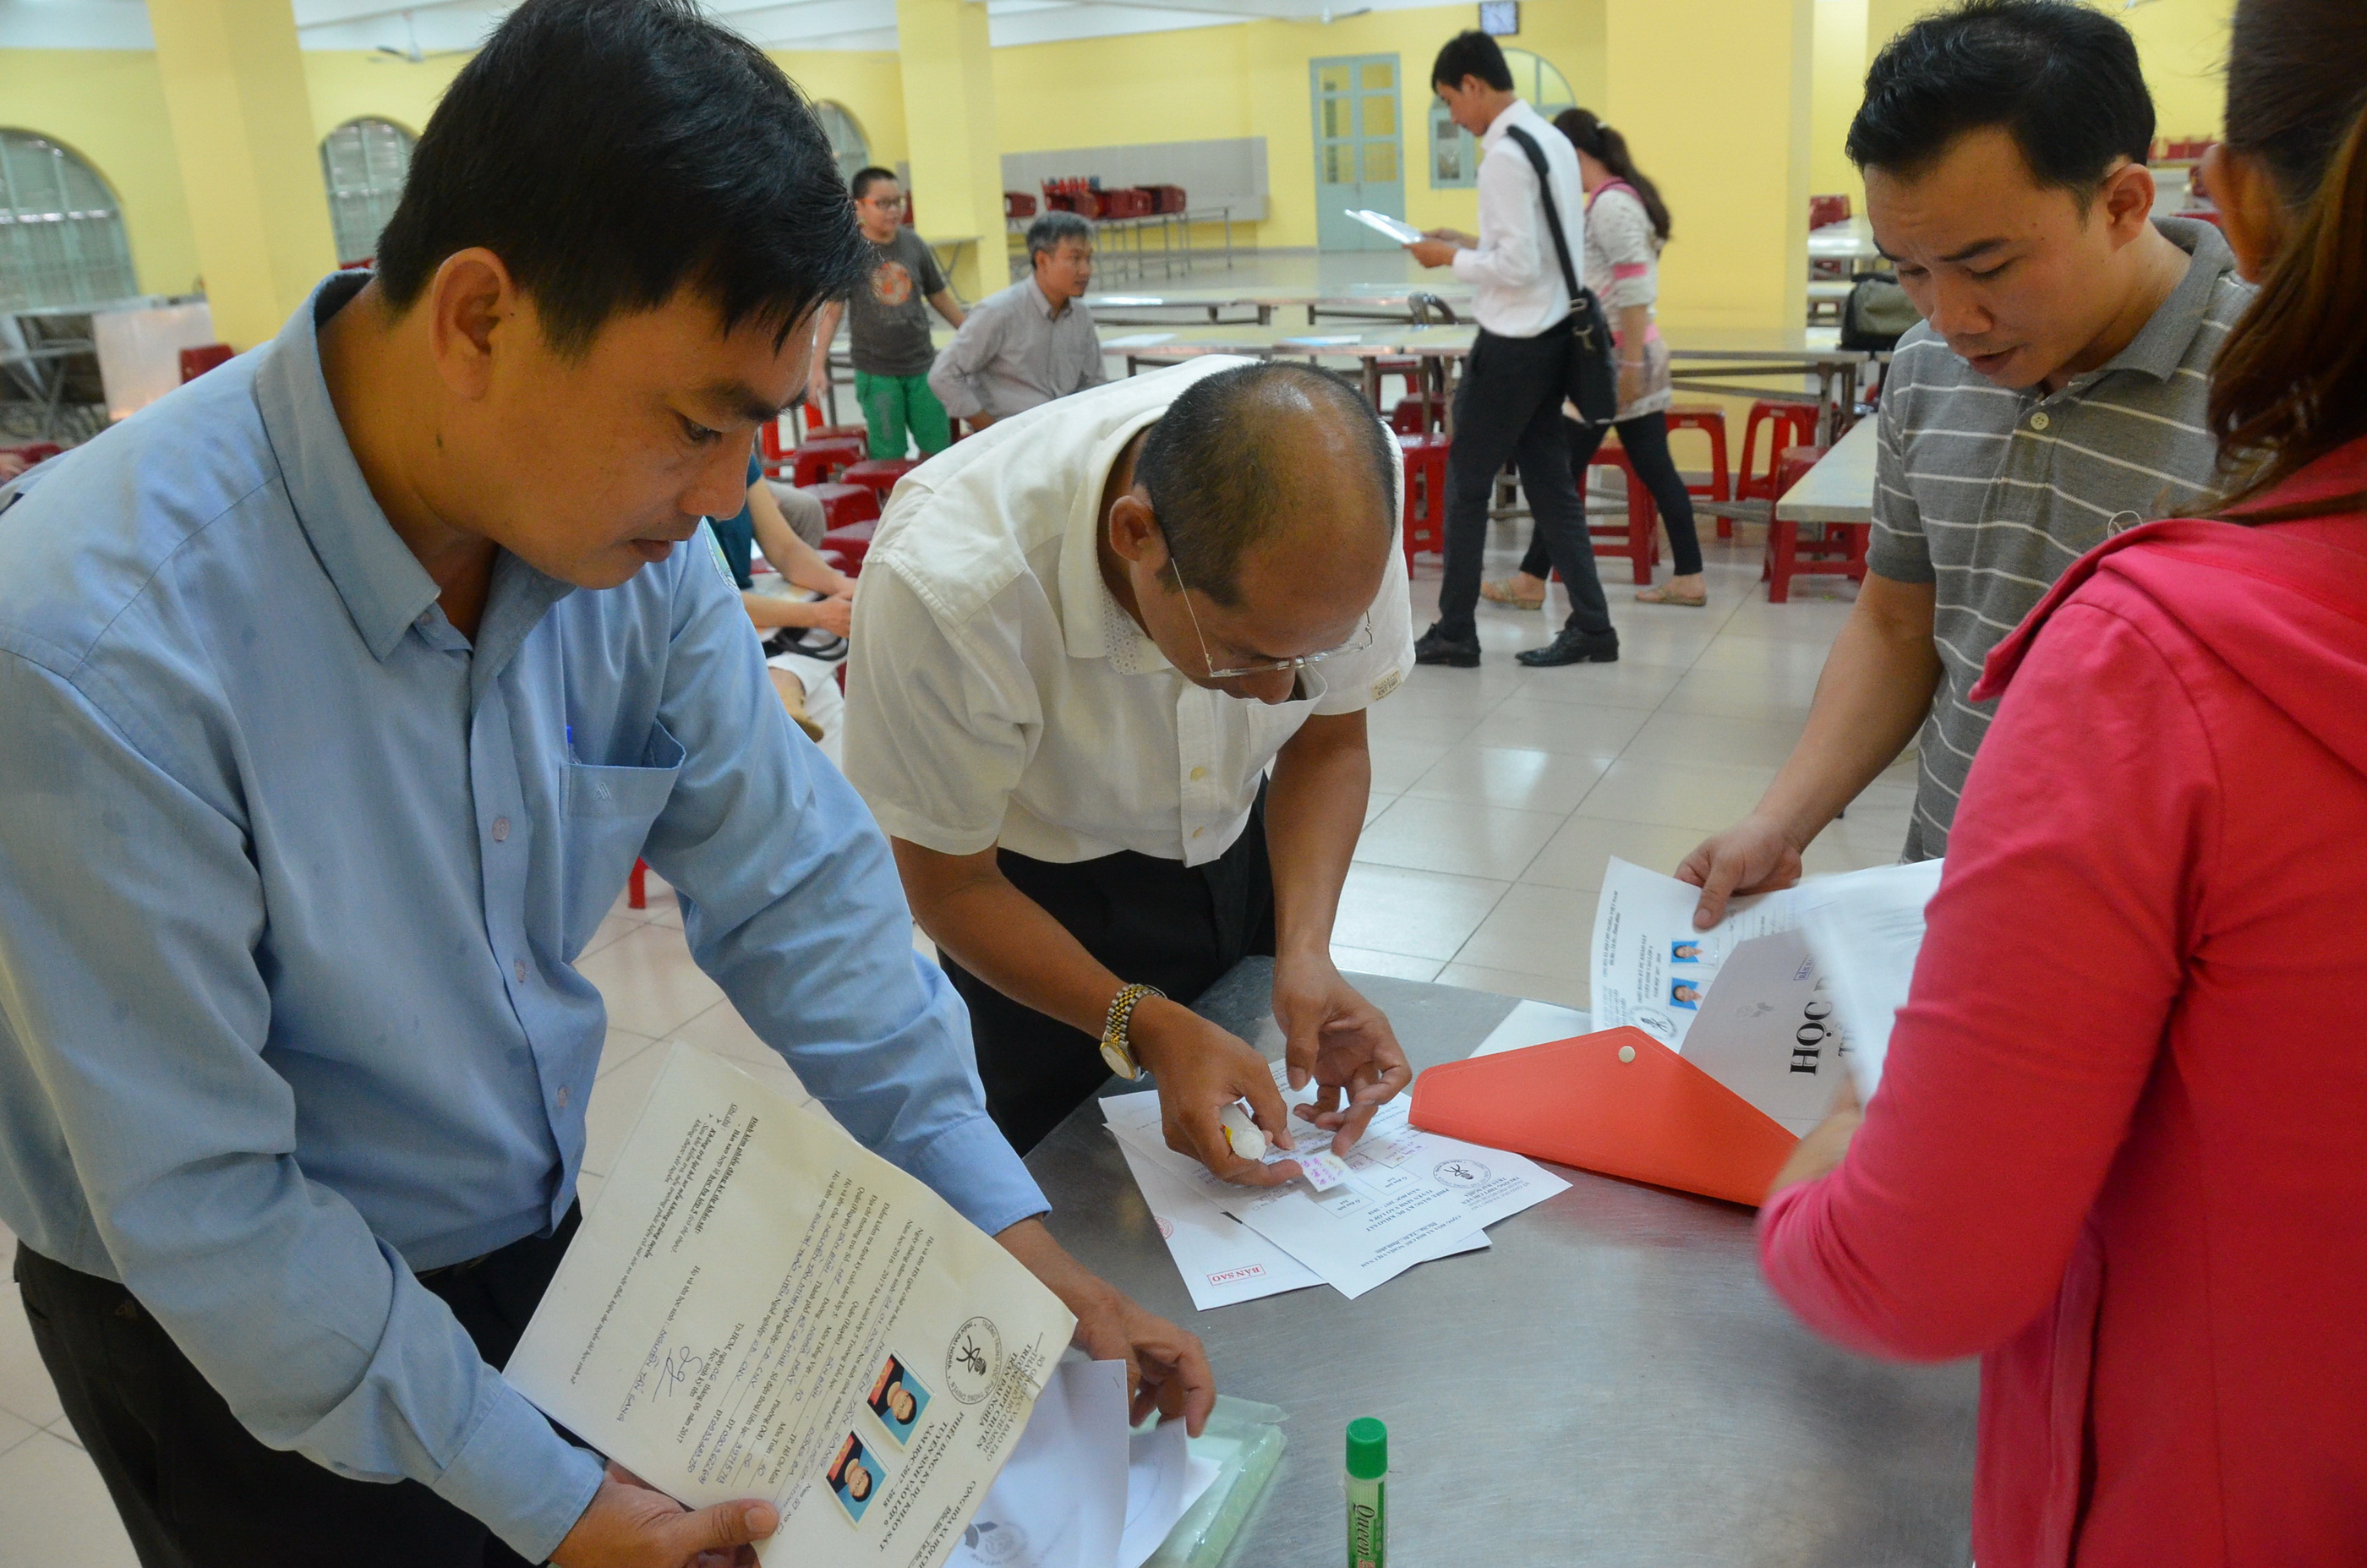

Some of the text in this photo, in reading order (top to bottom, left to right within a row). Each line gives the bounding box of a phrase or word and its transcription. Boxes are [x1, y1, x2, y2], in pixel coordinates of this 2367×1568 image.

[1789, 1001, 1833, 1075] HỌC
[726, 1103, 738, 1116] Ghi
[729, 1128, 741, 1142] Bản
[723, 1142, 732, 1154] sao
[701, 1116, 758, 1221] Đính kèm phiếu đăng dự khảo
[712, 1166, 721, 1175] lệ
[715, 1153, 727, 1167] hợp
[661, 1127, 716, 1221] Không nếu không
[704, 1173, 717, 1188] học
[831, 1169, 841, 1181] Họ
[842, 1177, 853, 1188] Họ
[692, 1196, 705, 1209] lớp
[823, 1188, 832, 1199] tên
[835, 1197, 845, 1207] tên
[828, 1207, 839, 1221] cha:
[841, 1186, 865, 1230] Quận (Huyện)
[842, 1194, 878, 1262] Địa thường Số
[901, 1218, 914, 1235] Năm
[895, 1233, 906, 1247] học
[925, 1235, 934, 1247] Họ
[834, 1201, 890, 1311] Điểm kiểm tra định cuối năm lớp
[888, 1246, 900, 1264] 2016
[888, 1227, 924, 1293] Ngày tháng năm sinh:
[916, 1254, 925, 1266] tên
[877, 1269, 889, 1287] 2017
[910, 1265, 920, 1278] HS
[1211, 1266, 1260, 1282] BẢN SAO
[666, 1265, 701, 1321] Họ và tên học sinh
[801, 1280, 823, 1314] Thành phố
[867, 1293, 877, 1307] học
[756, 1296, 781, 1338] Nghề nghiệp:
[813, 1296, 830, 1319] Đường
[861, 1306, 871, 1321] sinh
[768, 1303, 794, 1346] Nghề nghiệp:
[834, 1300, 859, 1345] Quận (Huyện)
[855, 1320, 865, 1333] lớp
[714, 1322, 745, 1369] Tp.HCM, ngày
[810, 1324, 832, 1359] Môn Tiếng
[839, 1338, 856, 1362] Trường
[688, 1347, 720, 1397] Học sinh tên
[847, 1363, 857, 1379] sinh
[828, 1377, 838, 1390] học
[615, 1392, 635, 1422] SANG
[745, 1370, 779, 1425] Số điện thoại liên
[998, 1384, 1013, 1410] THPT
[675, 1383, 711, 1443] tháng 06 năm 2017
[763, 1398, 781, 1424] Phường
[765, 1421, 786, 1454] Môn Toán
[981, 1429, 998, 1453] MINH
[767, 1433, 797, 1484] TP. Chí Minh
[817, 1431, 841, 1469] SANG
[882, 1443, 922, 1508] HỌC 2017 2018
[912, 1453, 929, 1478] SINH
[798, 1483, 812, 1498] Nam
[899, 1479, 915, 1500] VÀO
[959, 1479, 976, 1505] CỘNG
[888, 1499, 902, 1520] LỚP
[878, 1530, 893, 1552] SÁT
[1353, 1504, 1375, 1556] Queen
